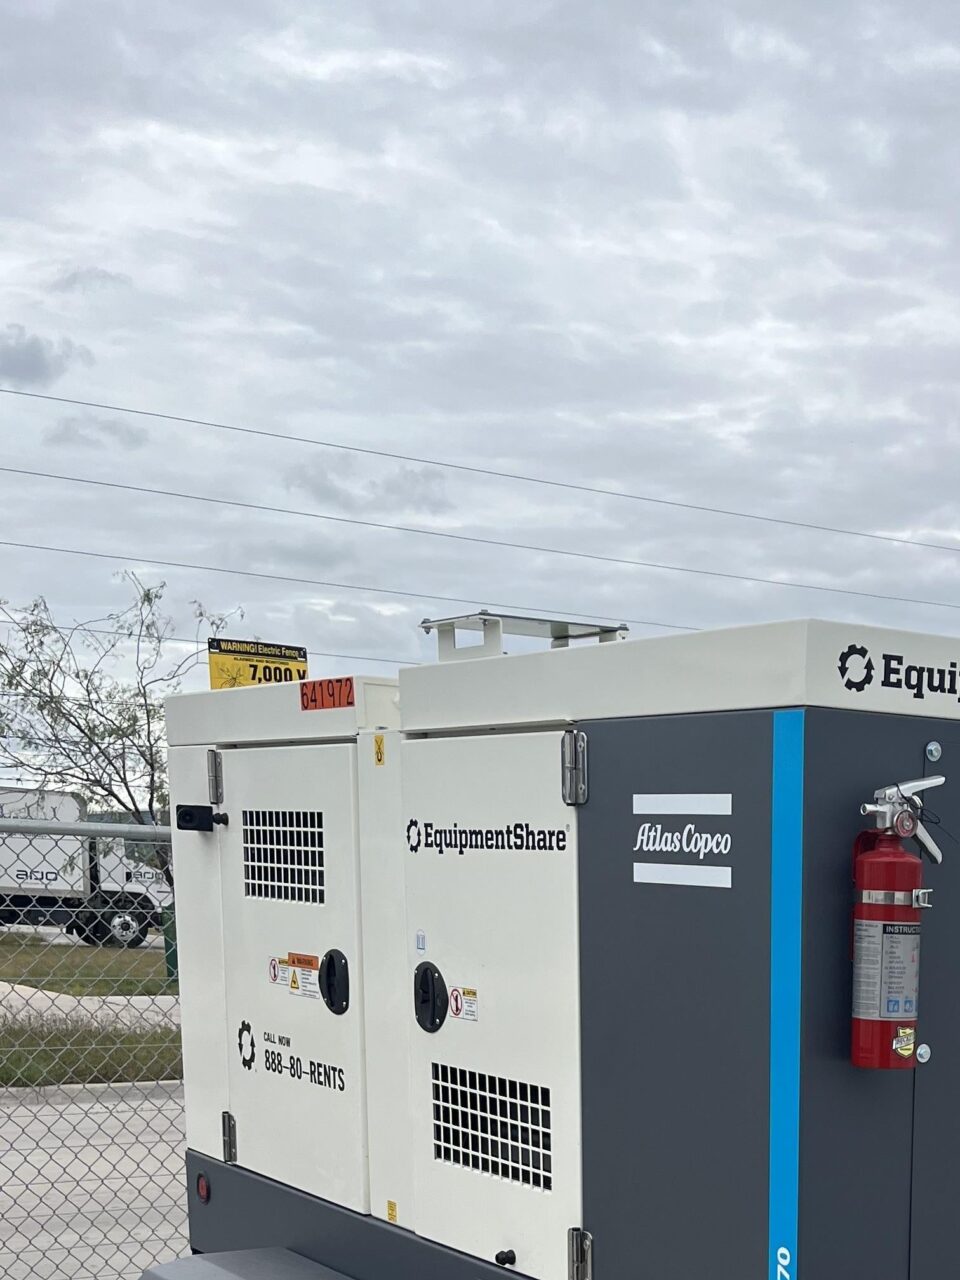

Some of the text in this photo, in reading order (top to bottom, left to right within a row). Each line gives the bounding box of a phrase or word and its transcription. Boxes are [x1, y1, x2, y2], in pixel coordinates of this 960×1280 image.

[220, 641, 299, 658] WARNING! Electric Fence
[249, 664, 293, 683] 7,000
[301, 678, 354, 709] 641972
[424, 822, 567, 855] EquipmentShare
[263, 1031, 291, 1047] CALL NOW
[264, 1049, 345, 1091] 888-80-RENTS
[777, 1246, 791, 1280] 70
